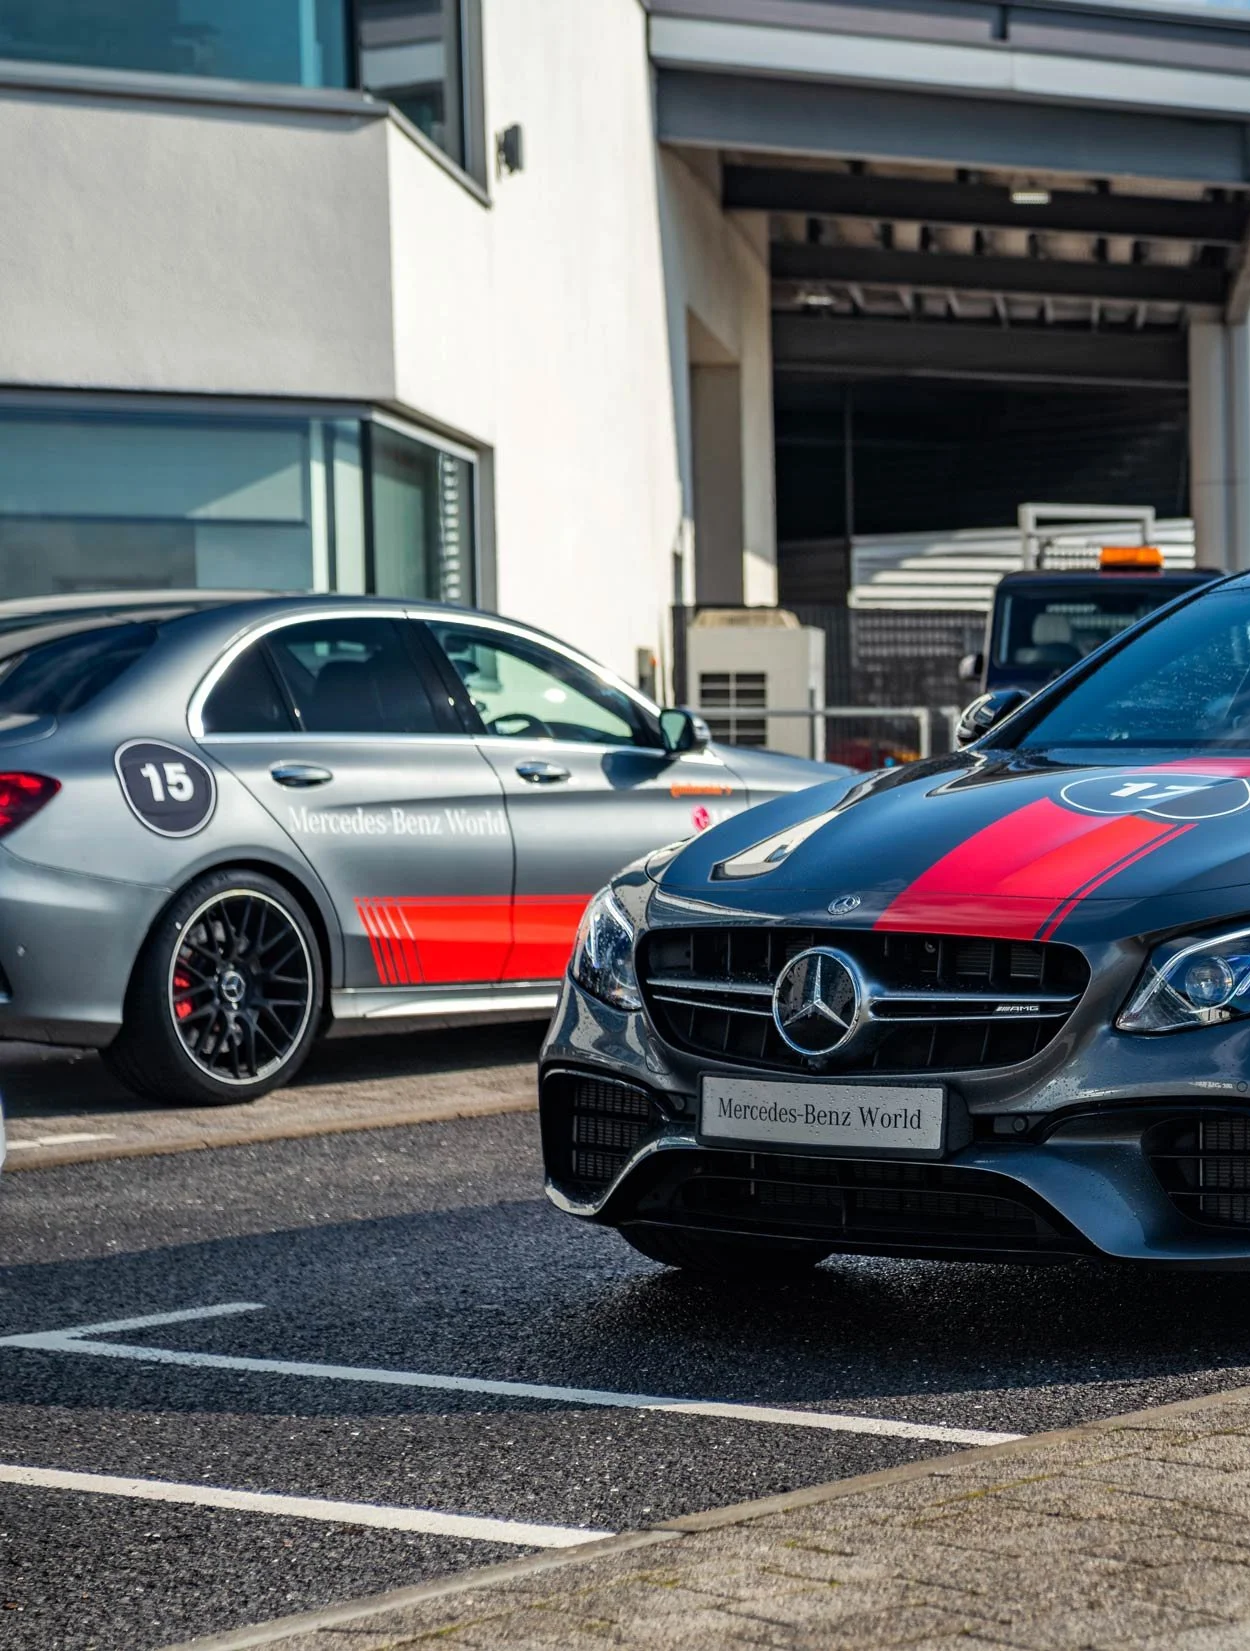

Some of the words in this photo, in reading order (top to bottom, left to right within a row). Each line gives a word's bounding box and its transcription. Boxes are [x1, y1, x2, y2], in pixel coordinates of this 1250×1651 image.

[140, 763, 194, 802] 15
[1109, 782, 1215, 799] 17
[288, 805, 443, 836] Mercedes-Benz
[444, 808, 508, 836] World
[718, 1097, 851, 1127] Mercedes-Benz
[858, 1106, 922, 1129] World
